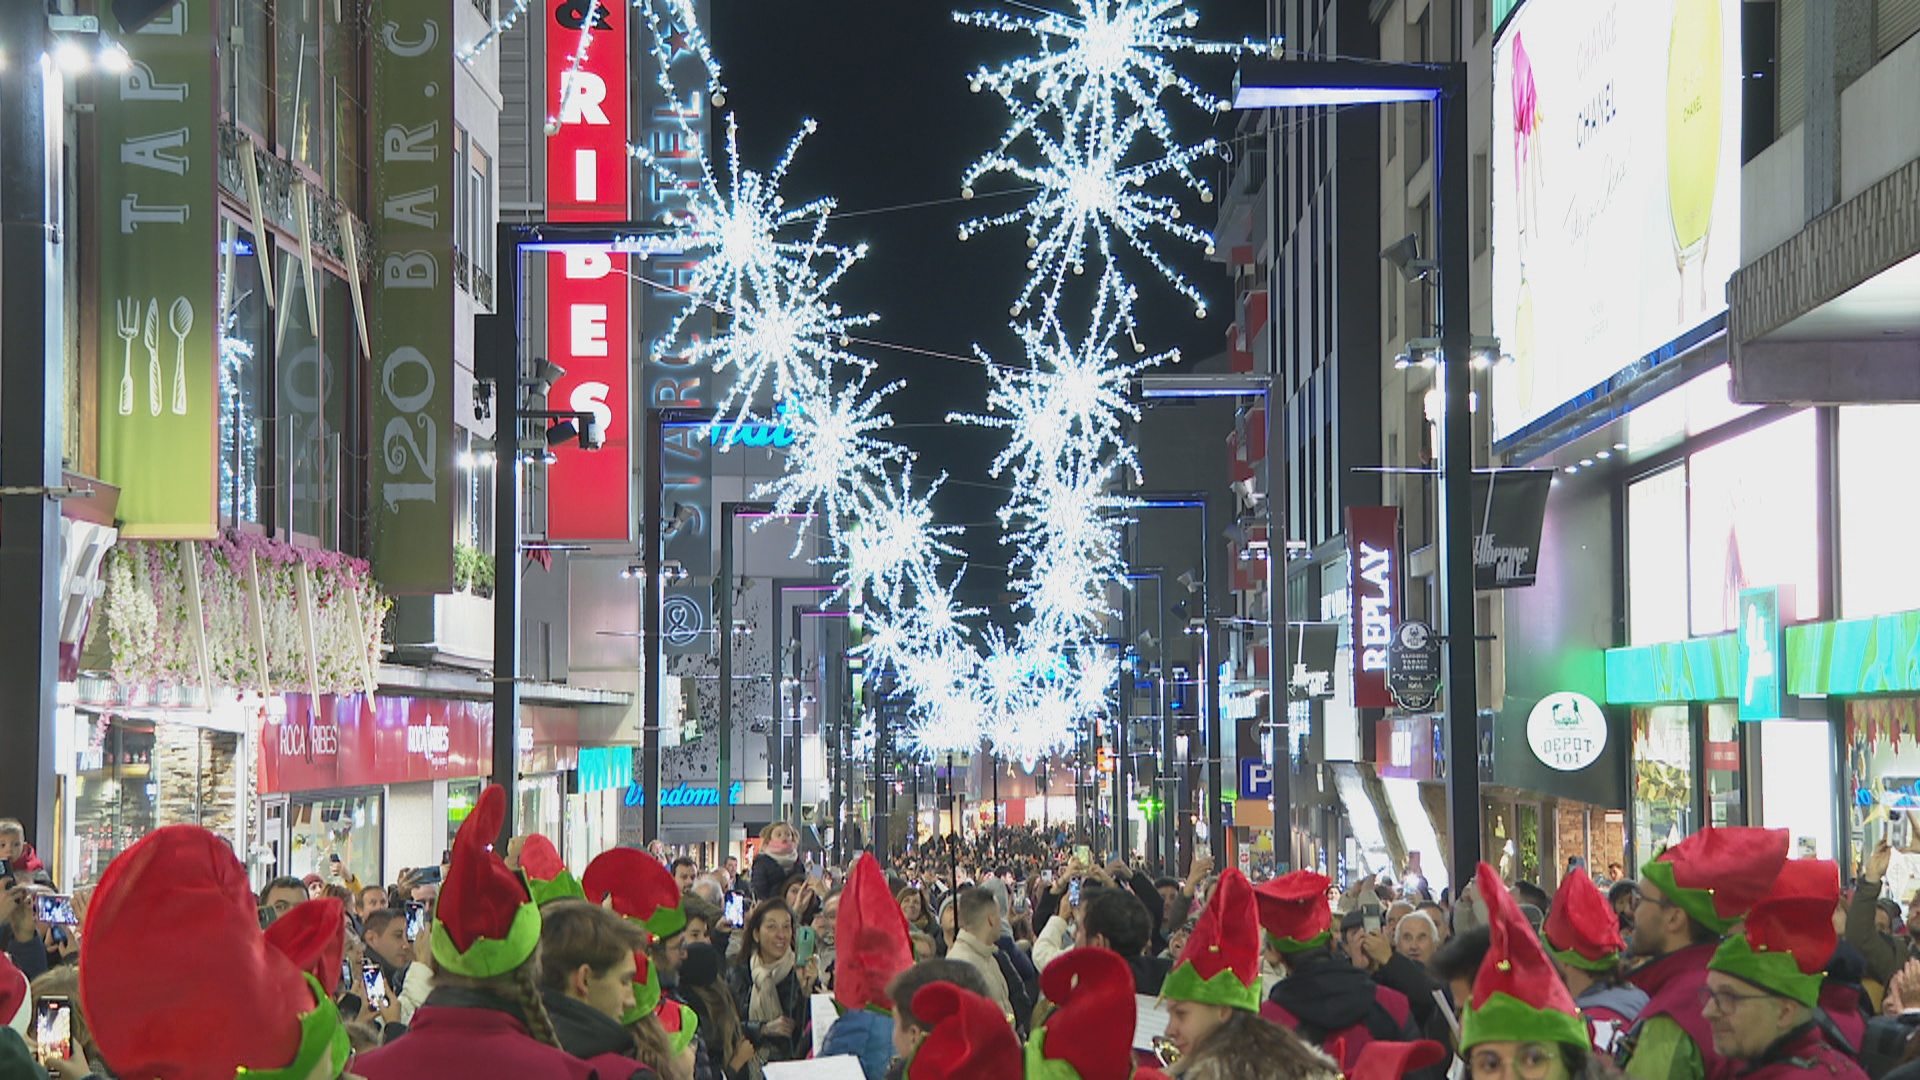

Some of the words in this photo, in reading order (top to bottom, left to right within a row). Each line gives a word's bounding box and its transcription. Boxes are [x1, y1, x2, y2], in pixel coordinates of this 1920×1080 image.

[1576, 78, 1616, 150] CHANEL
[560, 70, 613, 449] RIBES
[382, 345, 437, 514] 120
[1474, 533, 1496, 551] THE
[1473, 547, 1530, 567] SHOPPING
[1495, 561, 1523, 584] MILE
[1360, 541, 1391, 672] REPLAY
[280, 724, 306, 756] ROCA
[312, 725, 338, 755] RIBES
[1543, 737, 1592, 754] DEPOT
[1555, 751, 1580, 763] 101
[625, 779, 742, 806] Vndomt
[1249, 764, 1272, 793] P
